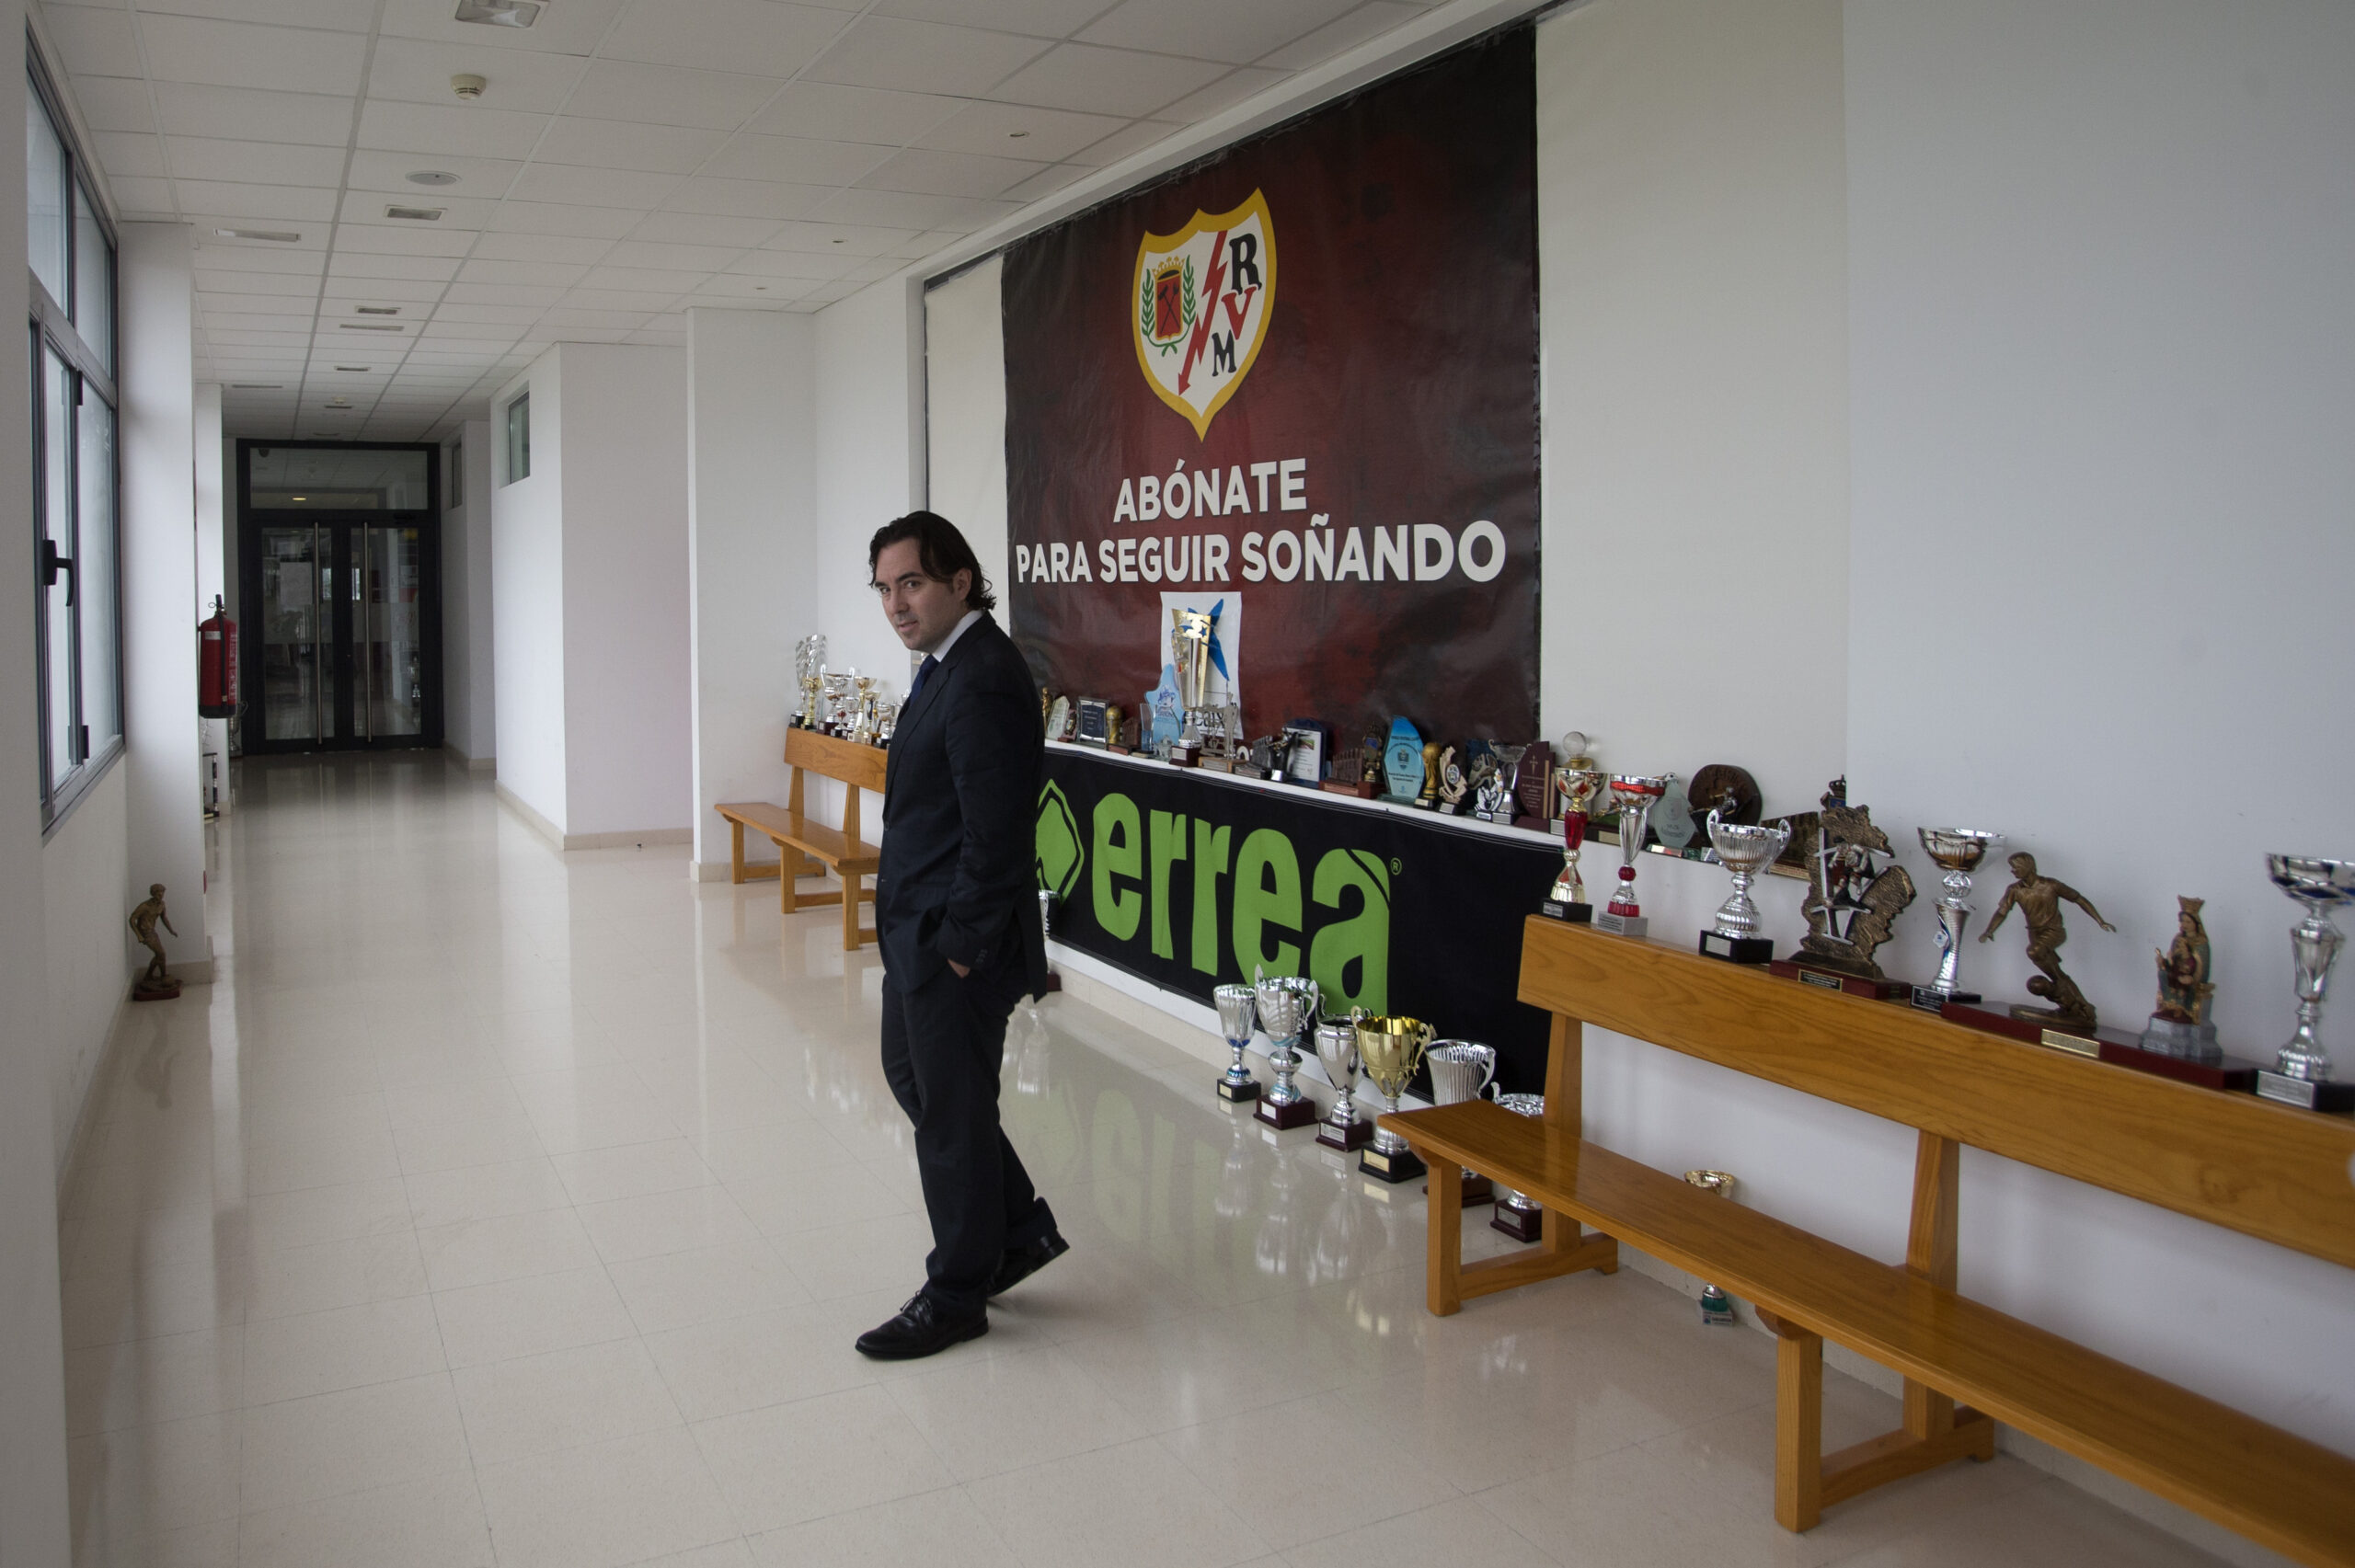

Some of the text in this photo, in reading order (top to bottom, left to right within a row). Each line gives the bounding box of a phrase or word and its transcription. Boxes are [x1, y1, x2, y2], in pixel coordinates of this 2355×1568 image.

[1229, 233, 1262, 295] R
[1221, 286, 1258, 340] V
[1212, 329, 1237, 377] M
[1113, 458, 1307, 523] ABÓNATE
[1016, 512, 1507, 584] PARA SEGUIR SOÑANDO
